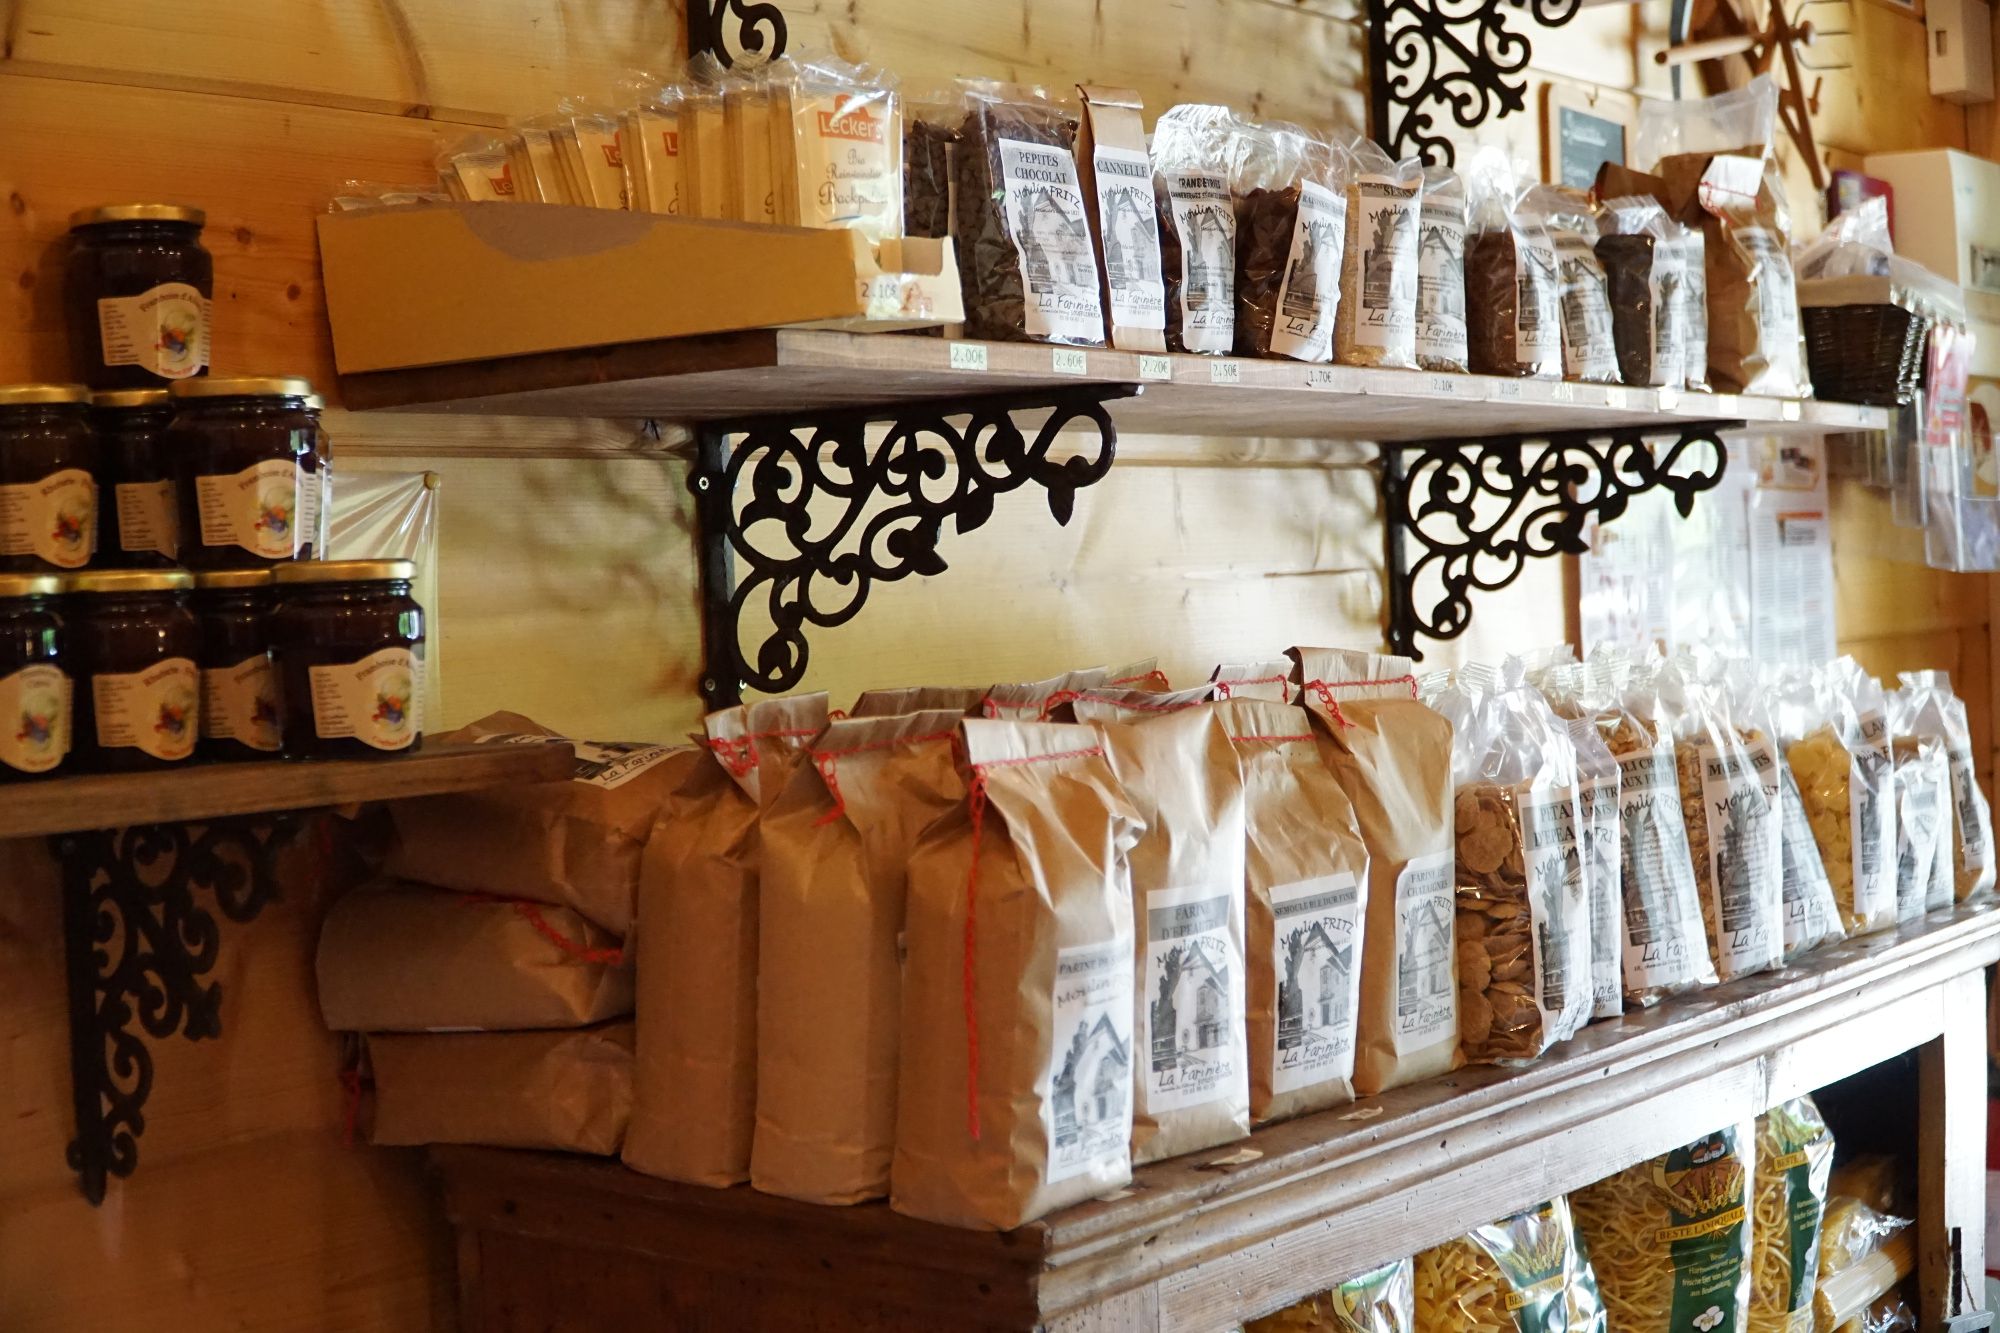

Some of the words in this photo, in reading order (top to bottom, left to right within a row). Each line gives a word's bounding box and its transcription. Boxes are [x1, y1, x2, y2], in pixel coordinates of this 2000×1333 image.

[1018, 151, 1059, 168] PEPITES
[1014, 166, 1067, 184] CHOCOLAT
[1096, 159, 1149, 179] CANNELLE
[1050, 185, 1081, 210] FRITZ
[1130, 186, 1153, 209] FRITZ
[1179, 204, 1214, 225] Moulin
[1368, 204, 1411, 224] Moulin
[1039, 292, 1052, 307] La
[1192, 310, 1207, 325] La
[1367, 308, 1385, 323] La
[1286, 317, 1303, 333] La
[952, 346, 985, 365] 2.00€
[1055, 356, 1084, 370] 2.60€
[1142, 361, 1169, 374] 2.20€
[1213, 363, 1238, 377] 2.50€
[1309, 370, 1332, 384] 1.70€
[1433, 378, 1454, 393] 2.10€
[1620, 775, 1643, 789] AUX
[1534, 845, 1581, 883] Moulin
[1433, 895, 1453, 912] FRITZ
[1790, 900, 1805, 918] La
[1323, 916, 1354, 935] FRITZ
[1731, 929, 1749, 949] La
[1642, 942, 1661, 962] La
[1402, 1015, 1415, 1029] La
[1282, 1048, 1298, 1064] La
[1159, 1069, 1175, 1088] La
[1659, 1224, 1691, 1241] BESTE
